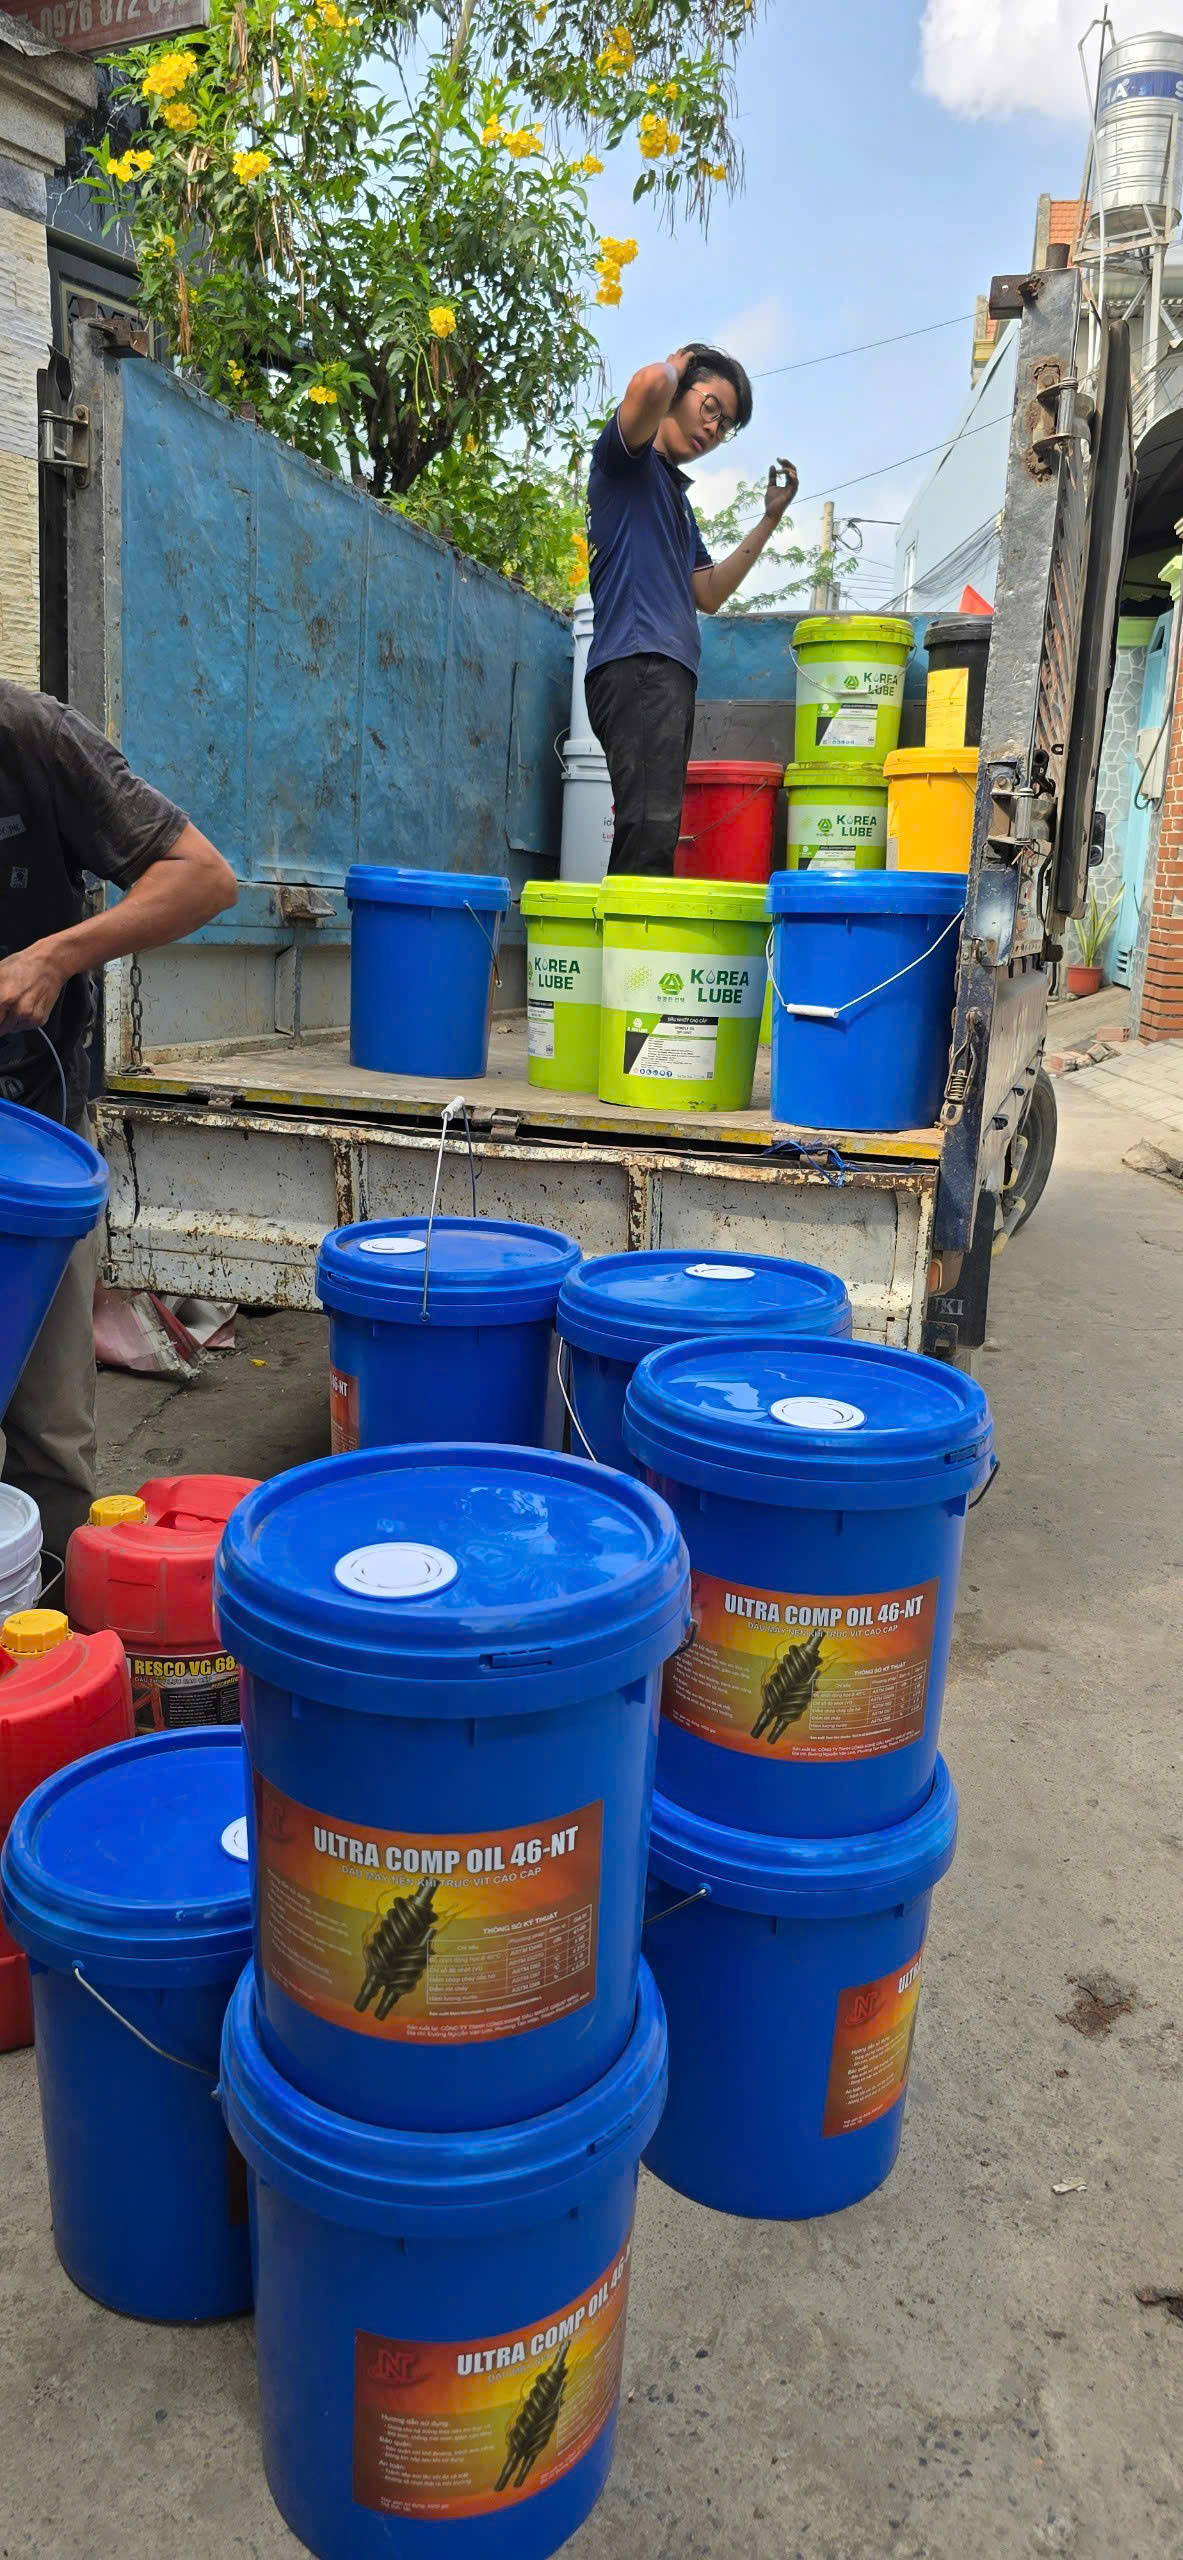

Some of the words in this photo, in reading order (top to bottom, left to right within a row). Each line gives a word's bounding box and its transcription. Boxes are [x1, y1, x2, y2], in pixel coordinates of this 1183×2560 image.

[40, 2, 93, 37] 0976
[863, 672, 898, 685] KOREA
[868, 684, 895, 696] LUBE
[836, 815, 877, 826] KOREA
[841, 827, 873, 837] LUBE
[534, 957, 581, 974] KOREA
[538, 974, 574, 990] LUBE
[690, 969, 749, 986] KOREA
[697, 988, 743, 1004] LUBE
[724, 1592, 780, 1623] ULTRA
[784, 1604, 842, 1627] COMP
[846, 1606, 874, 1627] OIL
[877, 1595, 924, 1622] 46-NT
[134, 1659, 186, 1677] RESCO
[189, 1659, 212, 1676] VG
[313, 1825, 380, 1869] ULTRA
[385, 1846, 460, 1875] COMP
[466, 1845, 504, 1872] OIL
[510, 1825, 579, 1866] 46-NT
[457, 2341, 525, 2376] ULTRA
[530, 2306, 585, 2357] COMP
[587, 2281, 609, 2318] OIL
